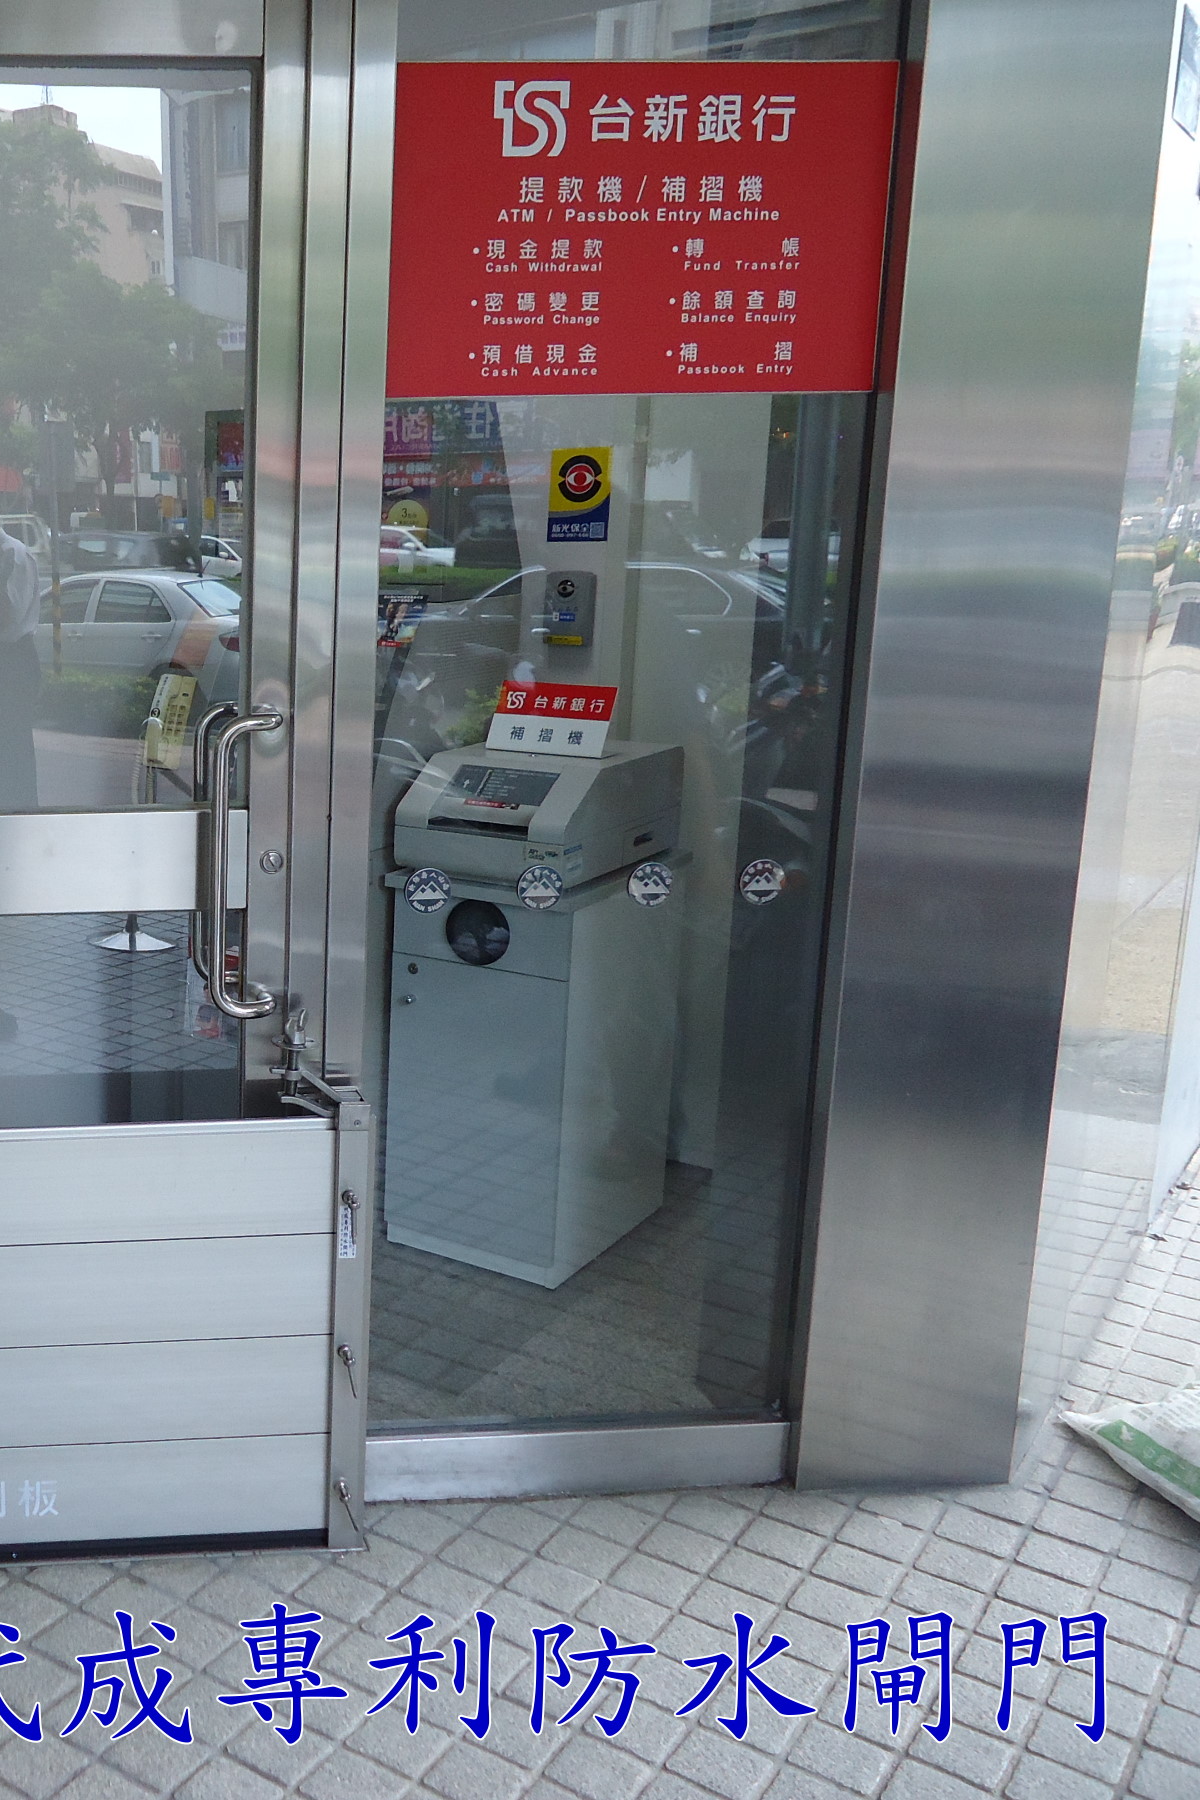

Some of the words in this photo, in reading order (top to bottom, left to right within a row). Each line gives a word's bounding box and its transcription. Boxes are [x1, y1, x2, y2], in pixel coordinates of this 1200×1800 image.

[589, 94, 796, 143] 台新銀行
[497, 208, 535, 223] ATM
[565, 207, 649, 222] Passbook
[656, 207, 702, 225] Entry
[708, 206, 780, 222] Machine
[487, 238, 603, 260] 現金提款
[485, 262, 518, 273] Cash
[528, 261, 603, 273] Withdrawal
[684, 261, 721, 271] Fund
[735, 260, 801, 271] Transfer
[484, 291, 600, 313] 密碼變更
[682, 289, 797, 311] 餘額查詢
[483, 315, 544, 326] Password
[552, 314, 600, 327] Change
[681, 312, 735, 324] Balance
[745, 312, 797, 325] Enquiry
[482, 343, 597, 365] 預借現金
[481, 366, 518, 377] Cash
[532, 366, 598, 377] Advance
[678, 364, 746, 375] Passbook
[756, 363, 793, 376] Entry
[533, 695, 606, 714] 台新銀行
[509, 725, 585, 746] 補摺機
